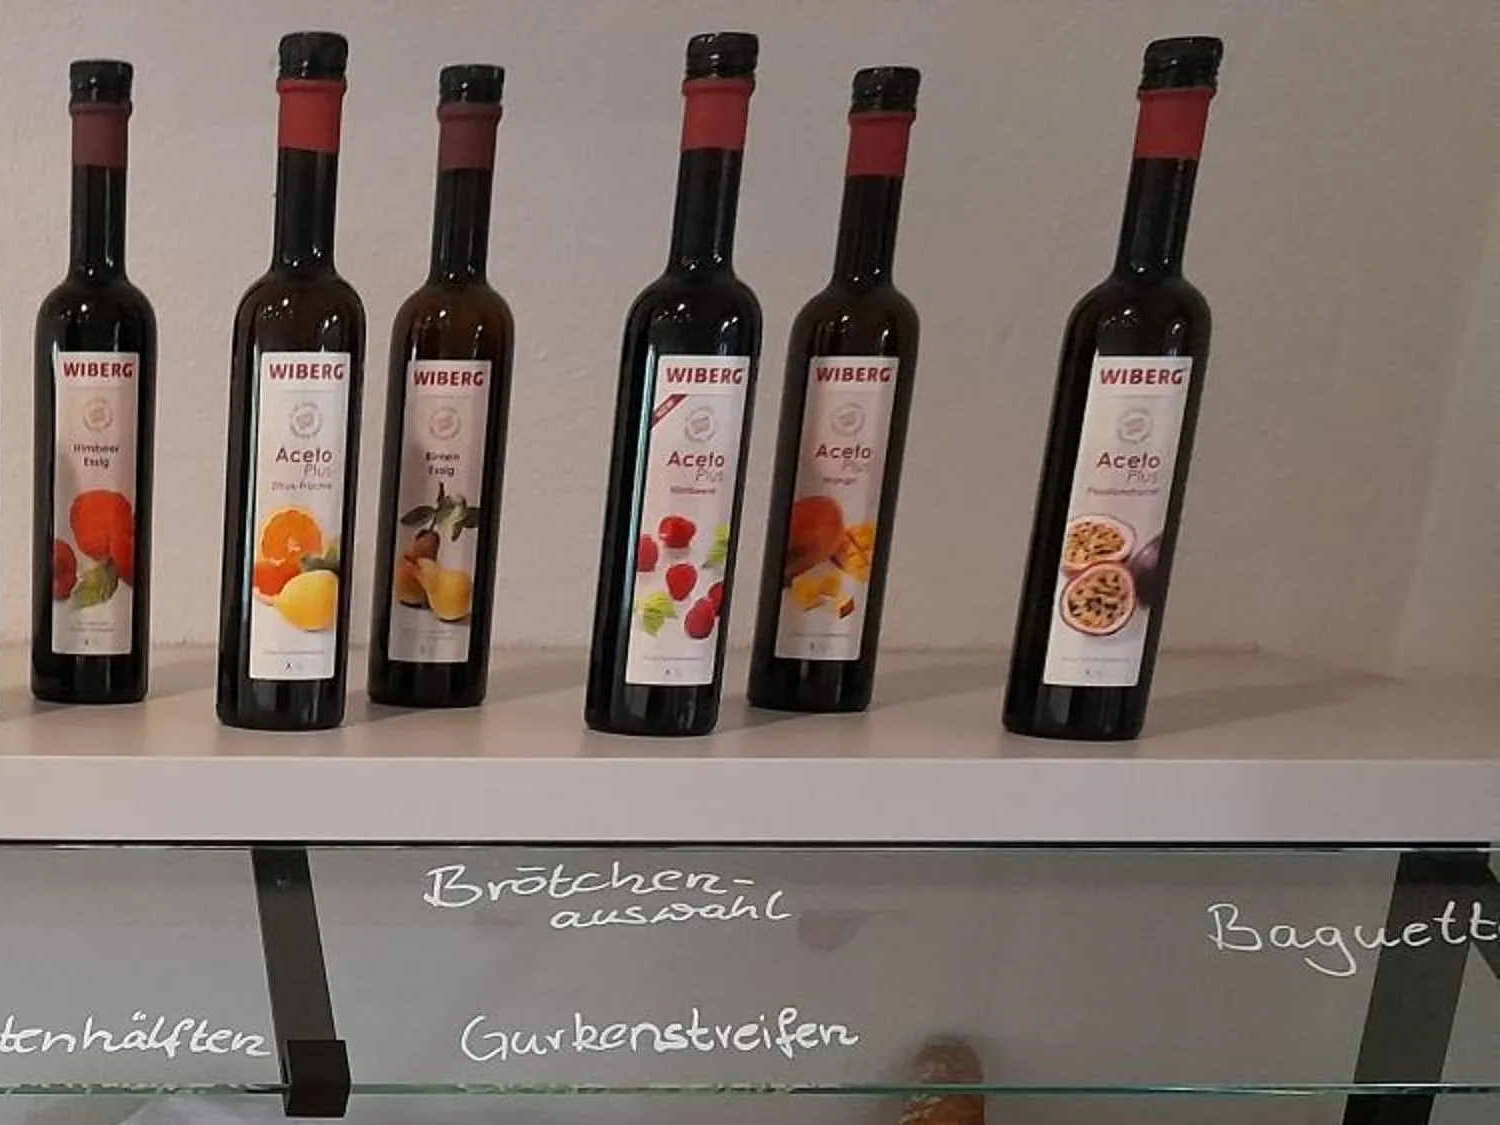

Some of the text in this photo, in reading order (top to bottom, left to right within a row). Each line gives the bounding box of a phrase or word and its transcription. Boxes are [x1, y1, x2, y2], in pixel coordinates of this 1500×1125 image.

[63, 362, 134, 378] WIBERG
[269, 362, 346, 381] WIBERG
[414, 370, 485, 387] WIBERG
[665, 367, 744, 384] WIBERG
[815, 366, 892, 383] WIBERG
[1100, 367, 1184, 385] WIBERG
[549, 890, 792, 930] auswahl
[1207, 900, 1500, 977] Baguett
[460, 1007, 860, 1062] Gurkenstreifen
